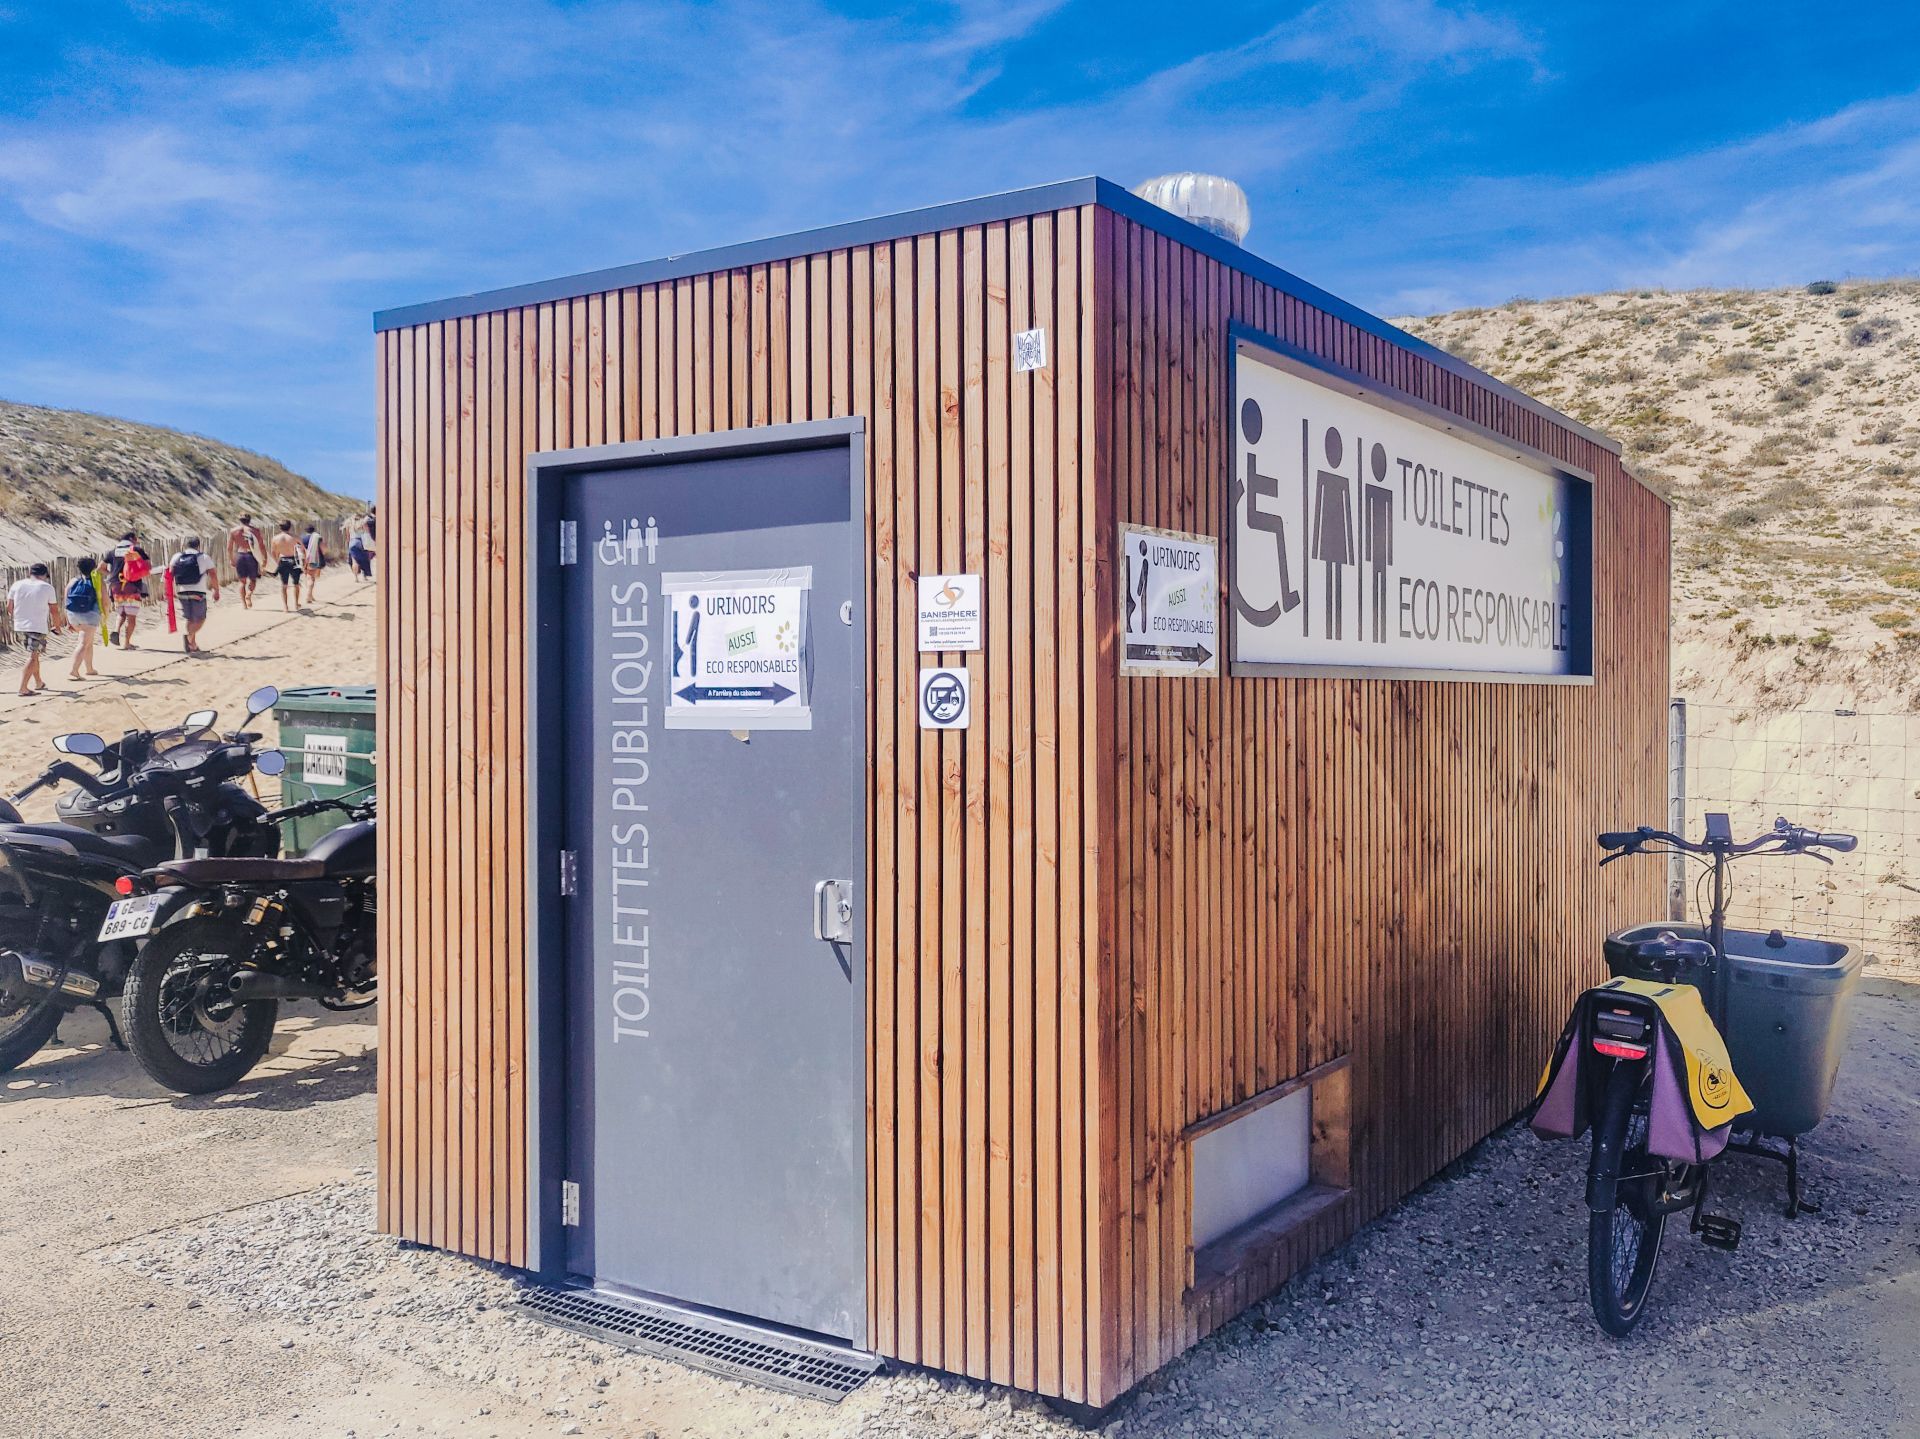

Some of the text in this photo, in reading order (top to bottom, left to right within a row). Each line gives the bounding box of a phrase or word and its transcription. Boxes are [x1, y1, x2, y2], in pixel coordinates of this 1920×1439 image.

[1396, 457, 1510, 546] TOILETTES
[1152, 545, 1200, 572] URINOIRS
[706, 595, 776, 616] URINOIRS
[1168, 588, 1187, 608] AUSSI
[1399, 576, 1441, 640] ECO
[920, 610, 978, 619] SANISPHERE
[1153, 616, 1214, 635] ECO RESPONSABLES
[727, 631, 756, 651] AUSSI
[706, 659, 798, 675] ECO RESPONSABLES
[611, 581, 653, 1044] TOILETTES PUBLIQUES
[105, 916, 149, 935] 689-CG
